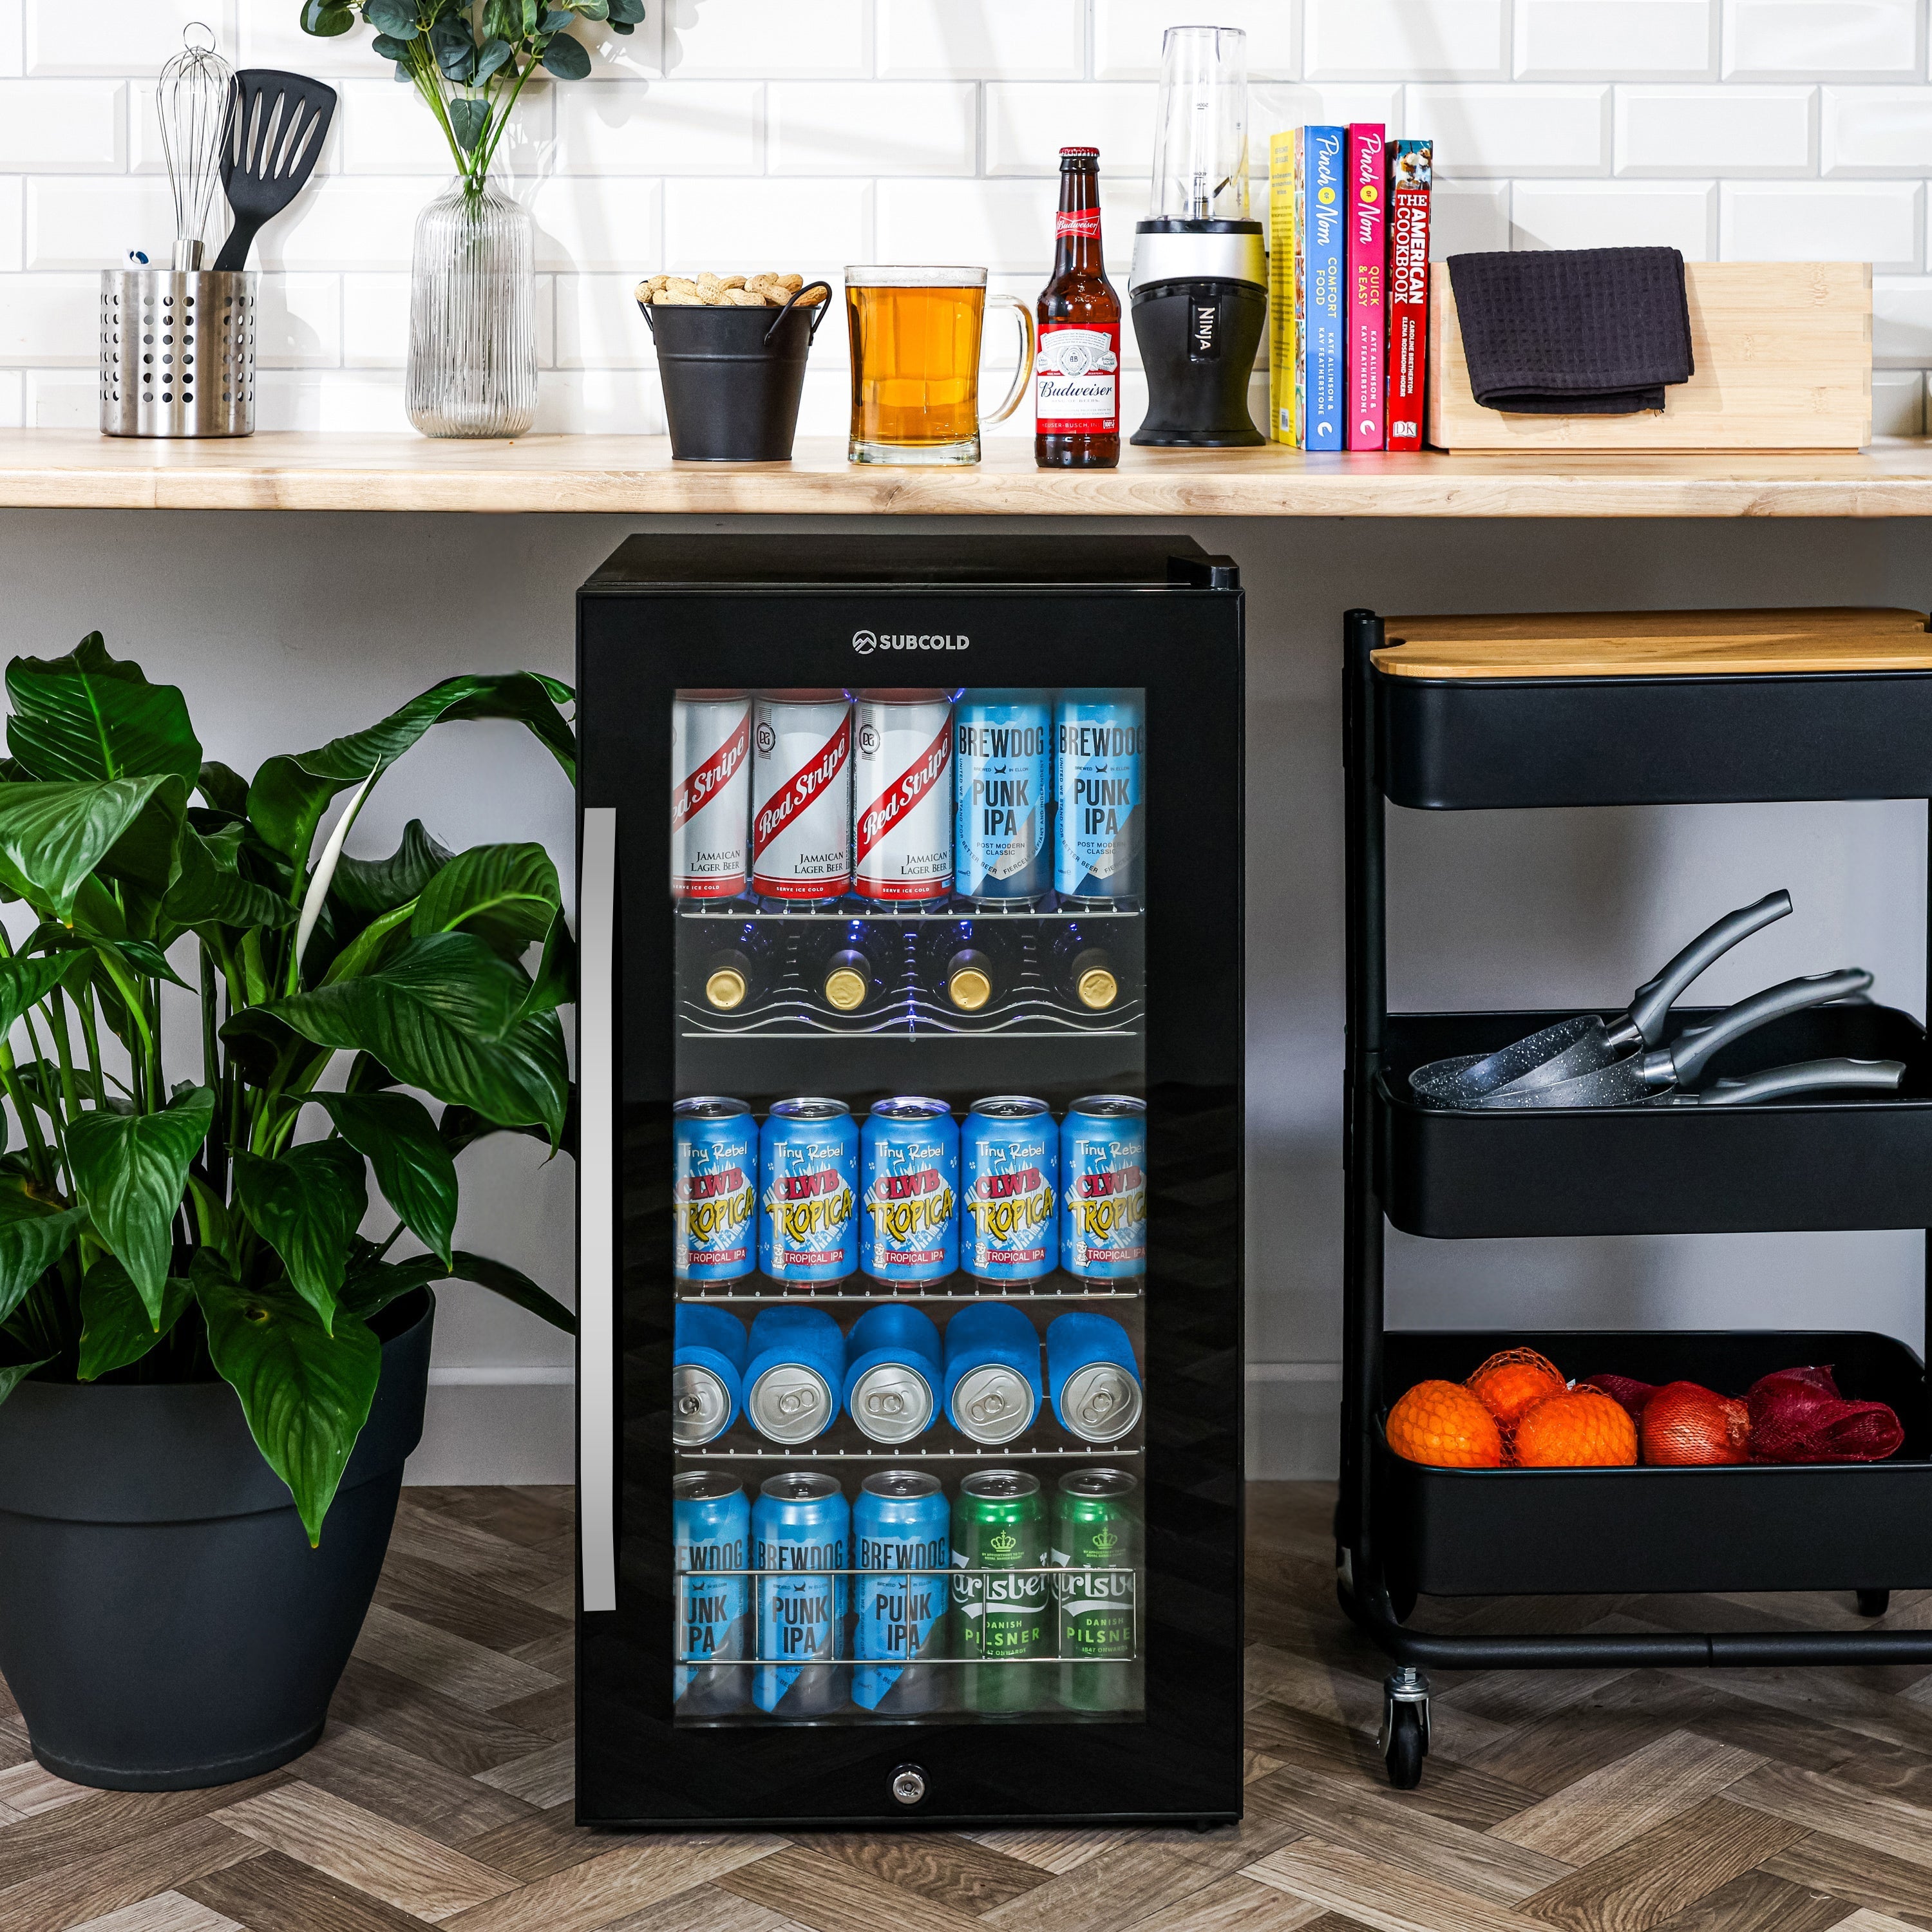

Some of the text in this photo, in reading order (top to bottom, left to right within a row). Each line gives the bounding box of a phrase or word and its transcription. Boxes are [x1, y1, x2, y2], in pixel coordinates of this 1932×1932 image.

[1316, 134, 1340, 187] Pinch
[1358, 133, 1382, 185] Pinch
[1397, 194, 1428, 207] THE
[1057, 220, 1097, 230] Budweiser
[1316, 204, 1339, 246] Nom
[1358, 203, 1381, 245] Nom
[1394, 207, 1411, 304] COOKBOOK
[1408, 207, 1427, 305] AMERICAN
[1316, 270, 1326, 306] FOOD
[1327, 257, 1338, 318] COMFORT
[1358, 277, 1368, 307] EASY
[1368, 266, 1380, 307] QUICK
[1195, 307, 1216, 351] NINJA
[1399, 339, 1408, 398] ROSEMOND-HOERR
[1039, 381, 1112, 398] Budweiser
[1396, 422, 1416, 435] DK
[879, 635, 970, 650] SUBCOLD
[960, 725, 1044, 758] BREWDOG
[1059, 724, 1145, 757] BREWDOG
[692, 735, 744, 803] Stripe
[759, 737, 845, 843] Red Stripe
[863, 737, 948, 845] Red Stripe
[973, 779, 1029, 807] PUNK
[1074, 778, 1130, 806] PUNK
[959, 786, 963, 797] WE
[961, 840, 980, 862] BETTER
[980, 861, 998, 875] BEER
[984, 809, 1018, 836] IPA
[1060, 785, 1064, 795] WE
[1062, 840, 1080, 862] BETTER
[1081, 860, 1099, 873] BEER
[1085, 808, 1119, 835] IPA
[691, 861, 740, 871] LAGER BEER
[697, 849, 740, 863] JAMAICAN
[794, 863, 843, 874] LAGER BEER
[800, 851, 844, 865] JAMAICAN
[901, 863, 947, 875] LAGER BEER
[906, 851, 947, 866] JAMAICAN
[677, 1141, 747, 1165] Tiny Rebel
[774, 1142, 843, 1167] Tiny Rebel
[875, 1141, 944, 1166] Tiny Rebel
[975, 1141, 1045, 1166] Tiny Rebel
[1075, 1139, 1145, 1164] Tiny Rebel
[677, 1167, 744, 1202] CLWB
[773, 1168, 840, 1201] CLWB
[874, 1168, 940, 1201] CLWB
[975, 1167, 1041, 1200] CLWB
[1076, 1165, 1142, 1198] CLWB
[766, 1188, 852, 1243] TROPICA
[866, 1187, 952, 1242] TROPICA
[967, 1187, 1054, 1242] TROPICA
[688, 1249, 746, 1262] TROPICAL IPA
[784, 1251, 843, 1262] TROPICAL IPA
[885, 1250, 943, 1262] TROPICAL IPA
[987, 1249, 1045, 1261] TROPICAL IPA
[1087, 1249, 1130, 1260] TROPICAL
[758, 1540, 842, 1570] BREWDOG
[862, 1537, 945, 1569] BREWDOG
[773, 1595, 829, 1625] PUNK
[876, 1593, 932, 1622] PUNK
[1086, 1618, 1124, 1626] DANISH
[783, 1626, 817, 1654] IPA
[887, 1624, 920, 1651] IPA
